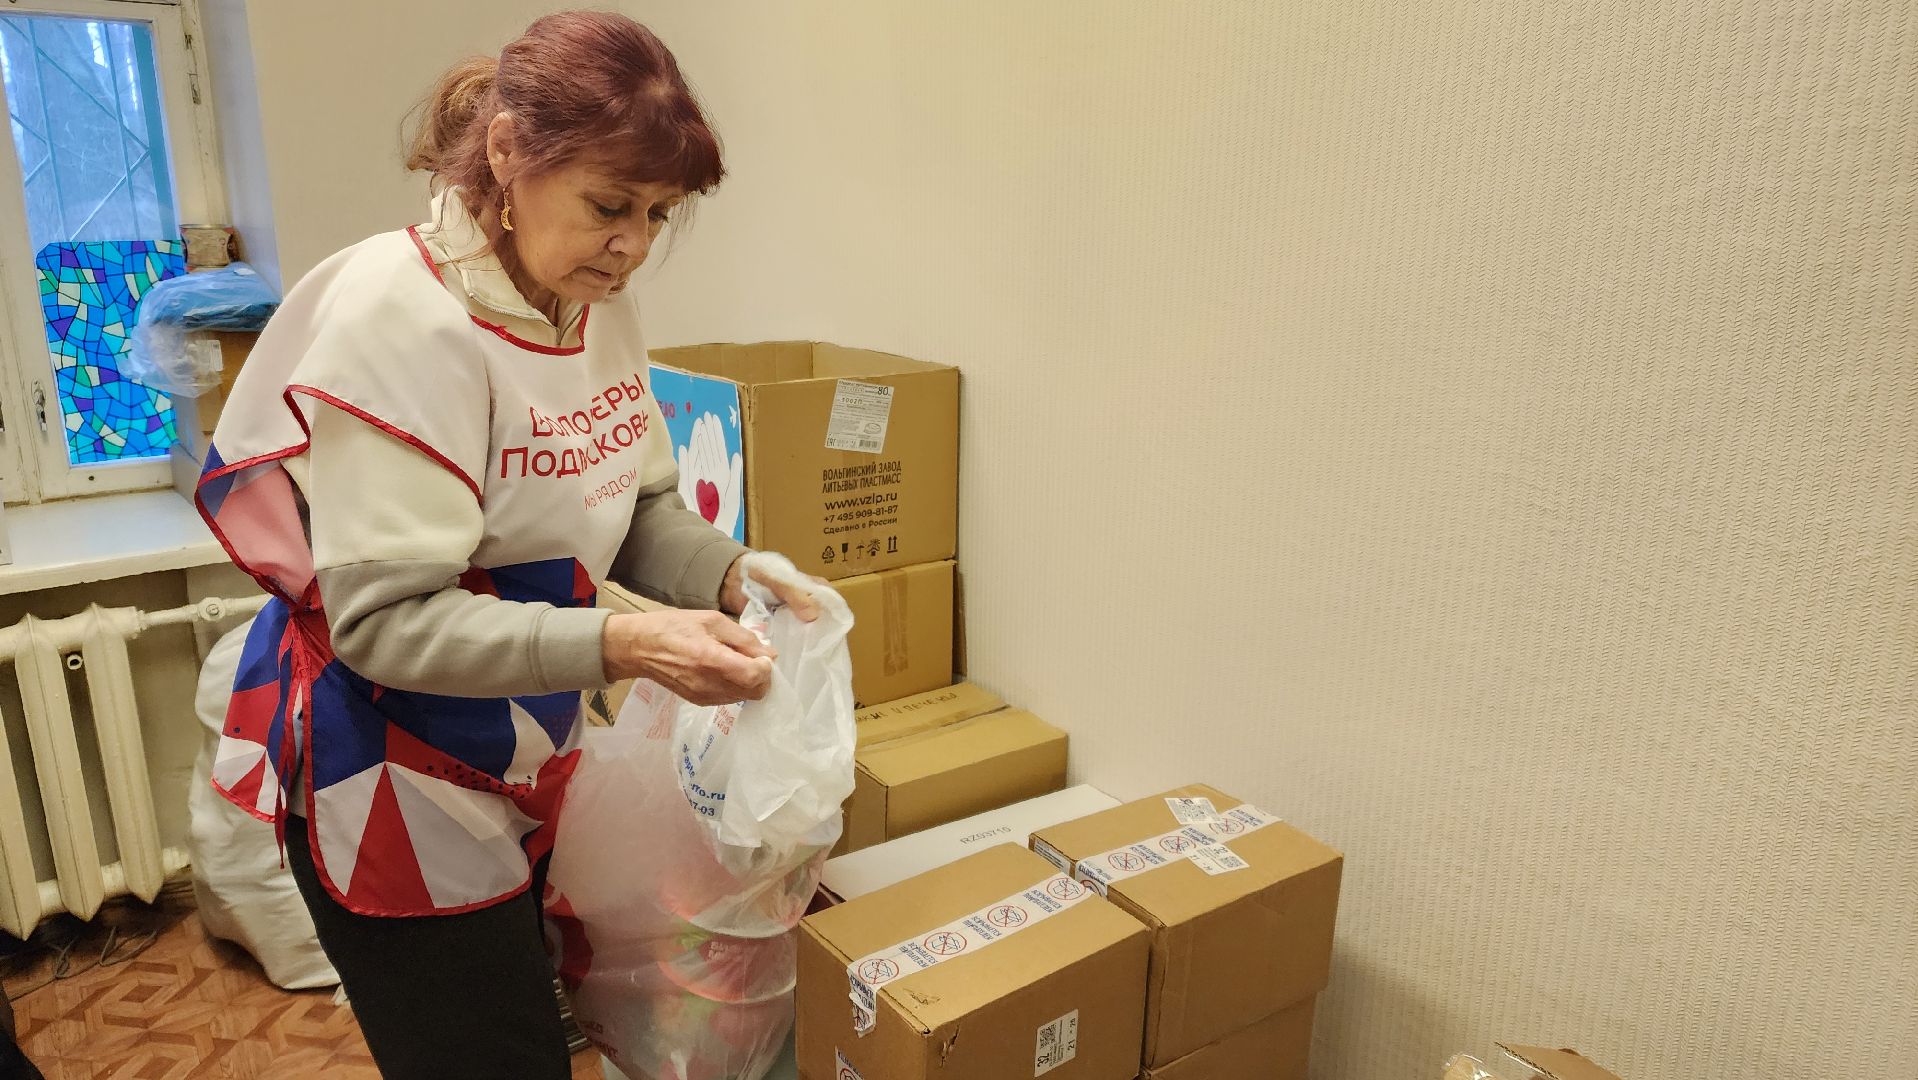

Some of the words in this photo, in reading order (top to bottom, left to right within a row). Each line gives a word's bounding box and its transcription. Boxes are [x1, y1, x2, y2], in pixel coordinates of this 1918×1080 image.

[822, 461, 877, 481] ВОЛЬГИНСКИЙ
[878, 460, 902, 474] ЗАВОД
[595, 467, 637, 501] РЯДОМ
[822, 480, 858, 494] ЛИТЬЕВЫХ
[859, 472, 902, 489] ПЛАСТМАСС
[824, 492, 898, 511] www.vzlp.ru
[823, 514, 836, 524] +7
[836, 511, 854, 522] 495
[855, 504, 899, 519] 909-81-87
[823, 524, 860, 535] Сделано
[868, 517, 898, 528] России
[1037, 1052, 1050, 1068] 32
